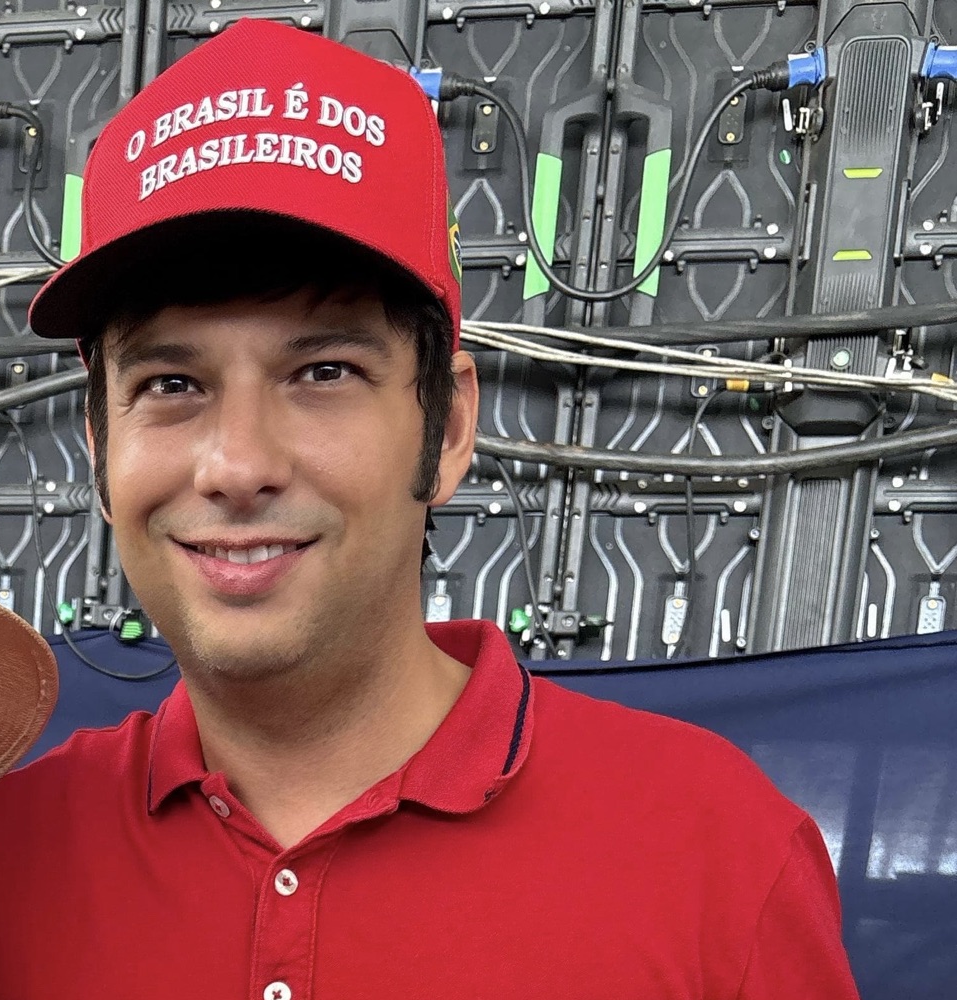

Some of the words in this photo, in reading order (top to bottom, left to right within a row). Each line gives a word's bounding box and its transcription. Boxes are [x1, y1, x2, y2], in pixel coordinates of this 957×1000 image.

[126, 129, 145, 162] O
[151, 88, 274, 147] BRASIL
[282, 82, 309, 120] É
[318, 95, 386, 147] DOS
[139, 133, 363, 201] BRASILEIROS
